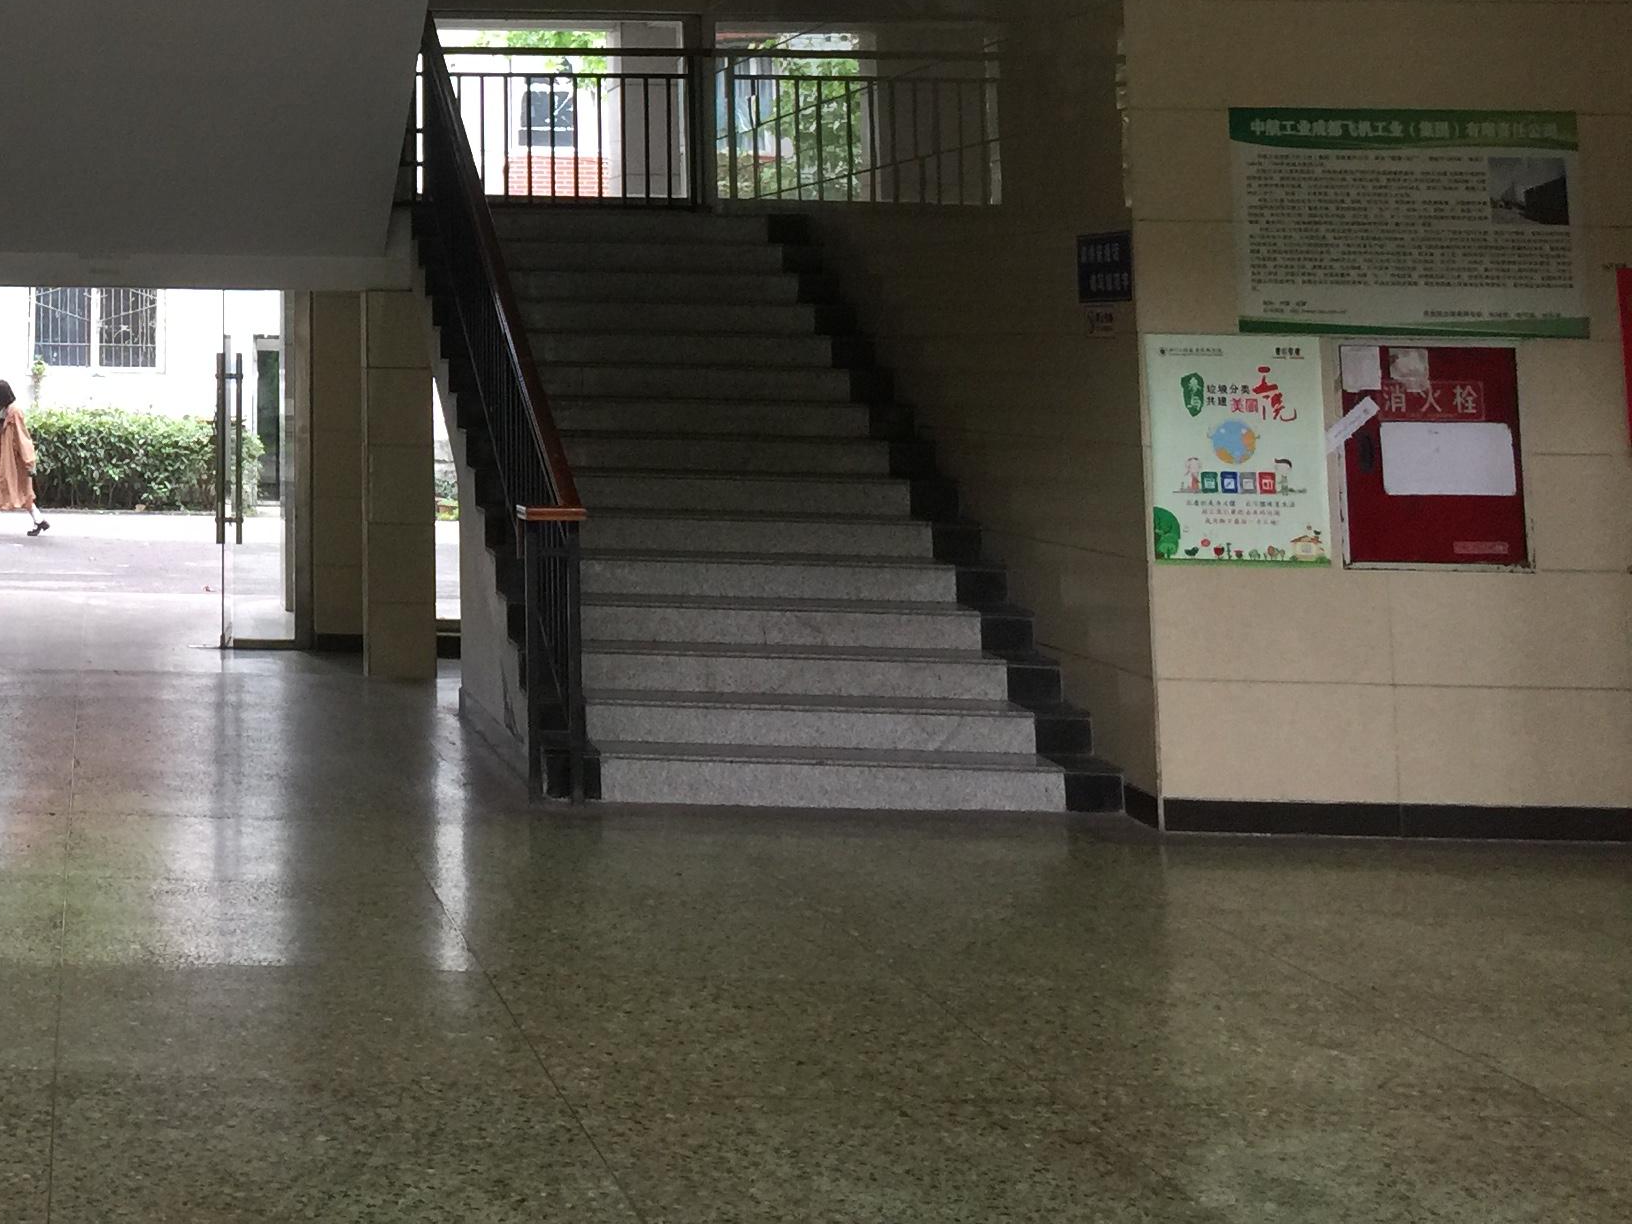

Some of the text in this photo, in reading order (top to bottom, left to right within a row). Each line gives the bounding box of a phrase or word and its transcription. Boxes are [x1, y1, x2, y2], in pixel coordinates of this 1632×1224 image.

[1206, 383, 1251, 395] 垃圾分类
[1383, 384, 1478, 414] 消火栓
